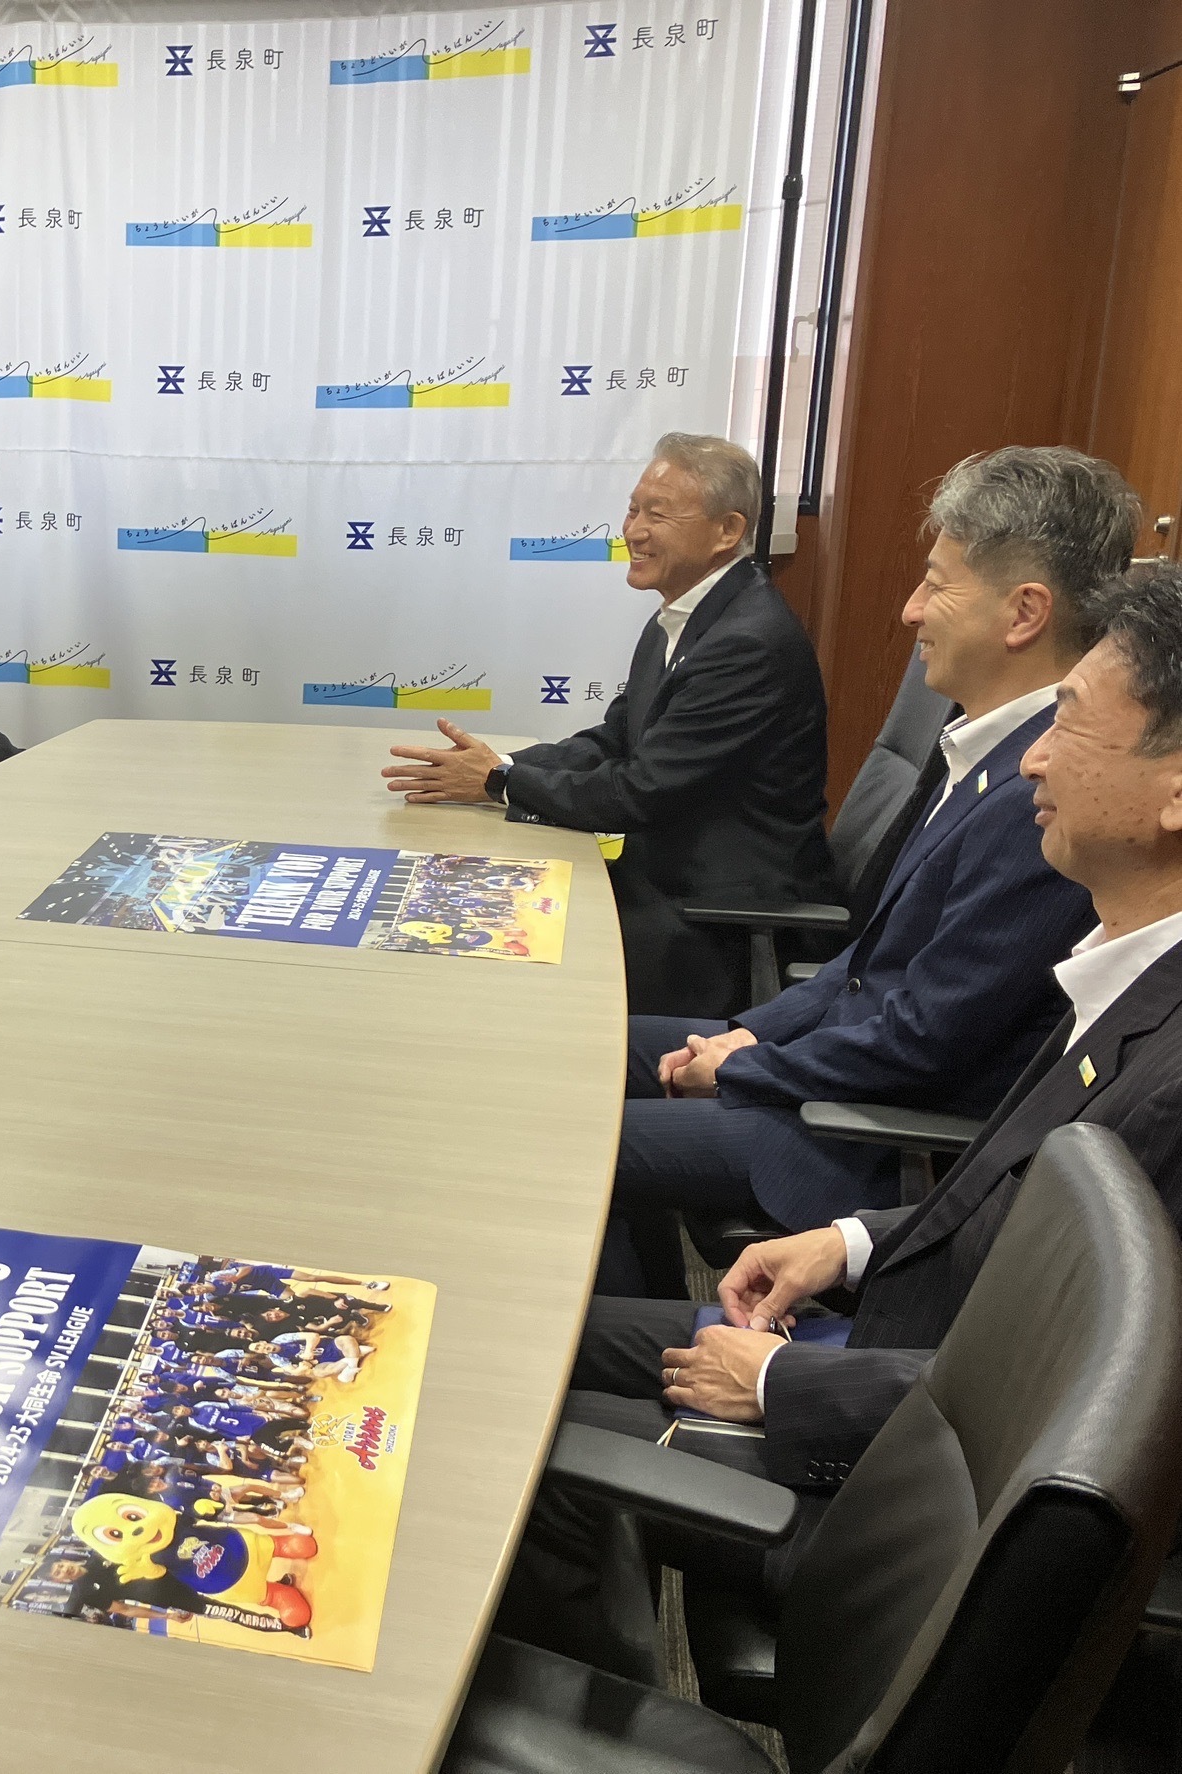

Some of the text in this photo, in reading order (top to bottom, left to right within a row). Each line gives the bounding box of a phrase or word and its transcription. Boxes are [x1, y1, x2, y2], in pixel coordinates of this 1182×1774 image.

[632, 19, 718, 50] 長泉町
[206, 48, 284, 71] 長泉町
[18, 208, 83, 229] 長泉町
[405, 207, 484, 231] 長泉町
[198, 371, 271, 392] 長泉町
[606, 366, 689, 391] 長泉町
[15, 511, 82, 531] 長泉町
[388, 526, 464, 547] 長泉町
[189, 666, 260, 686] 長泉町
[235, 853, 330, 926] THANK YOU
[300, 857, 367, 932] FOR YOUR SUPPORT
[15, 1373, 62, 1430] 大同生命
[54, 1305, 95, 1369] SV.LEAGUE
[220, 1416, 239, 1426] 5
[343, 1422, 356, 1441] TORAY
[204, 1604, 282, 1630] TORAY ARROWS
